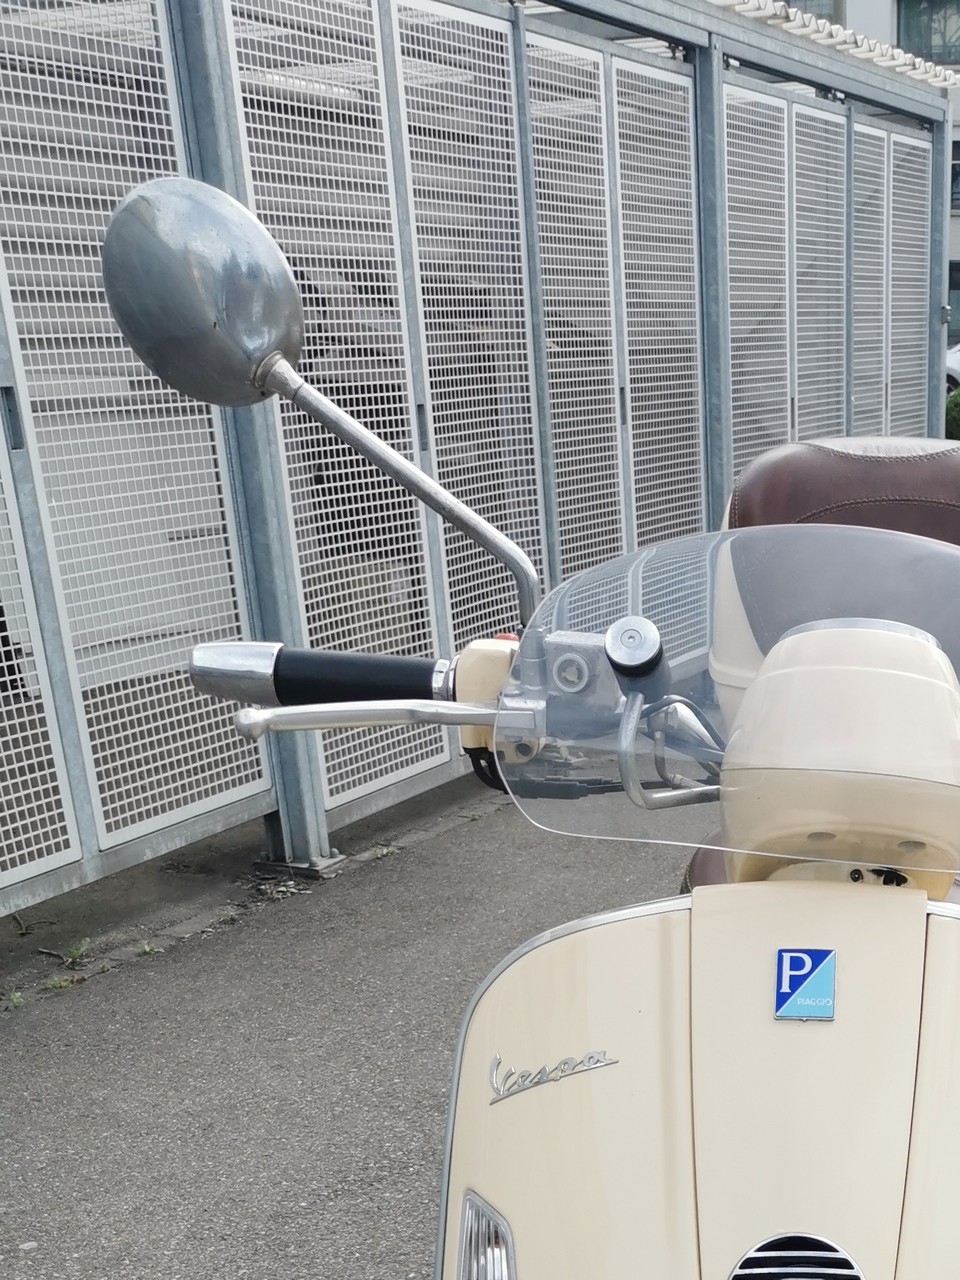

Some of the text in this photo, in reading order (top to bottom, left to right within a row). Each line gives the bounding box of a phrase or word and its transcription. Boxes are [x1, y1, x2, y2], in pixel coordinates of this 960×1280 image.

[780, 952, 812, 993] P
[797, 998, 832, 1006] PIAGGIO
[489, 1052, 617, 1102] Vespa
